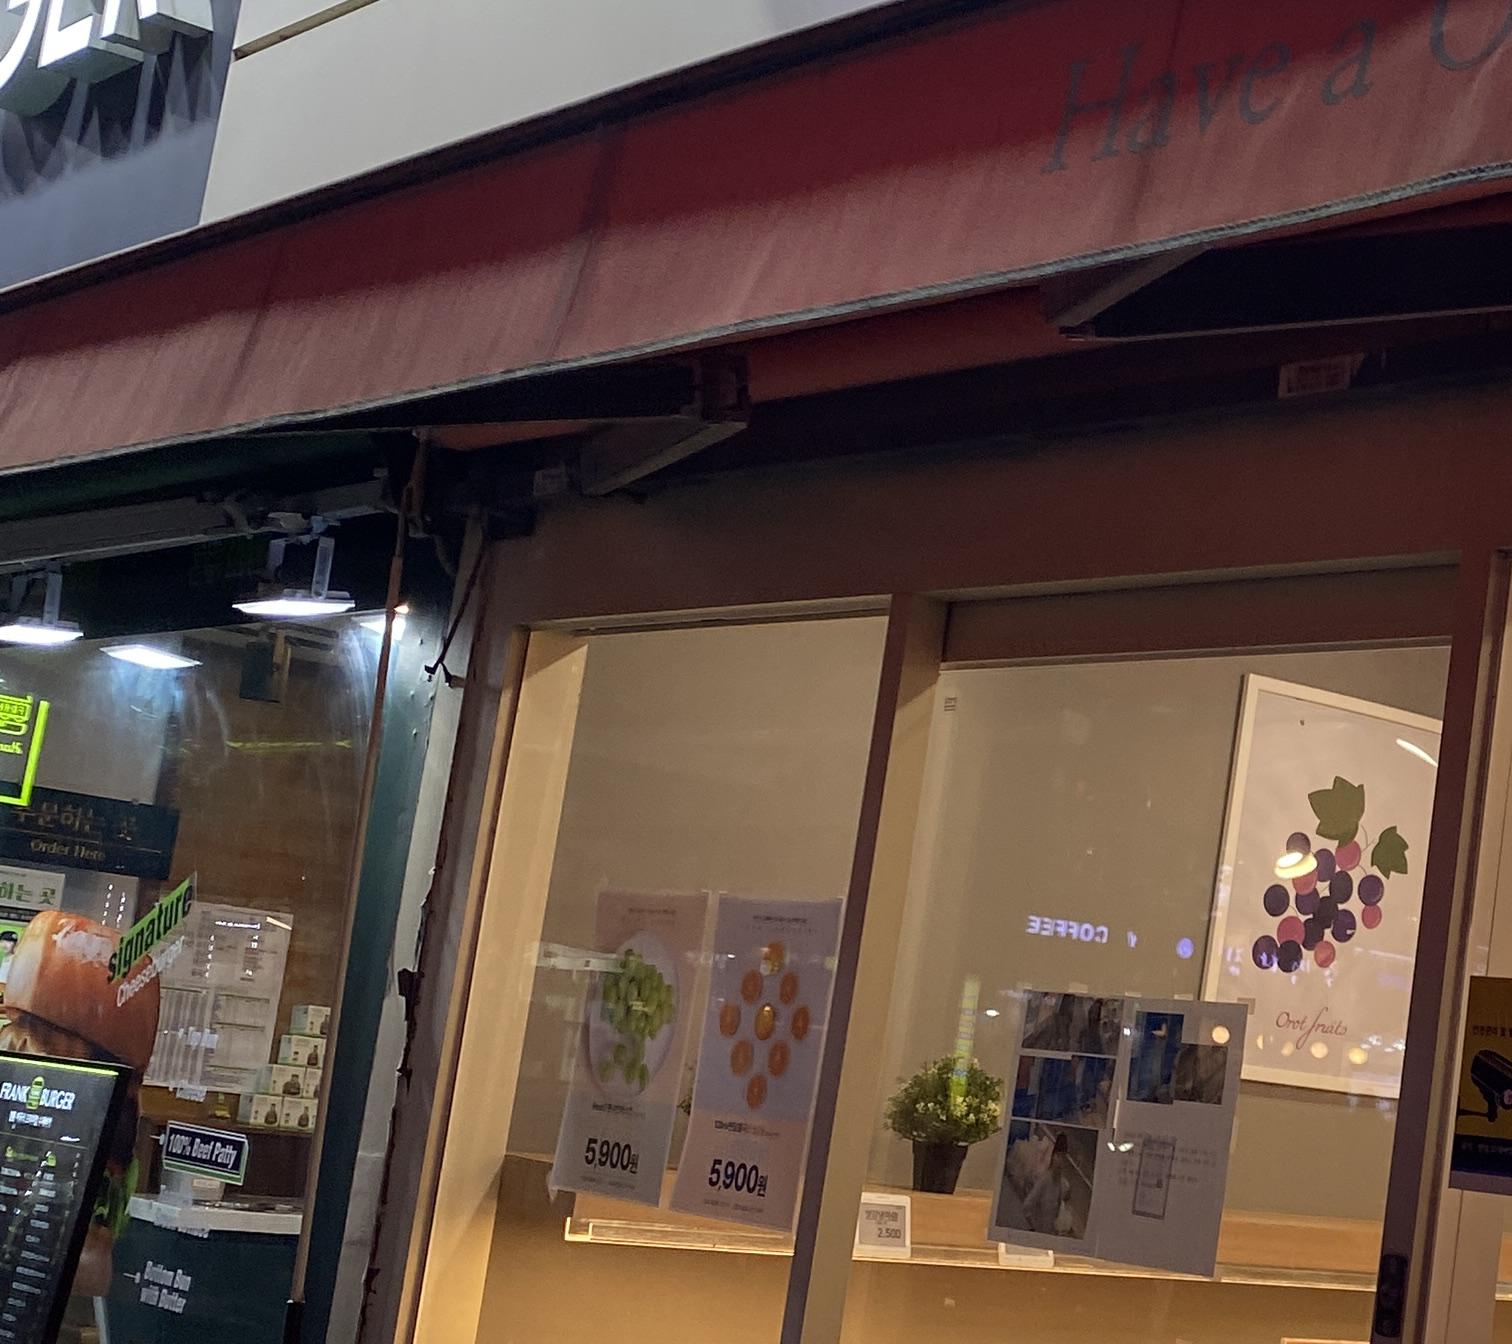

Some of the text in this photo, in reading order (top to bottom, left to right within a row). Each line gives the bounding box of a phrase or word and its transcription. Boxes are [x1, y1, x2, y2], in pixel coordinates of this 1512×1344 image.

[1041, 40, 1291, 174] Have
[1320, 17, 1379, 106] a
[30, 838, 70, 857] Order
[106, 884, 194, 985] signature
[1275, 1011, 1309, 1032] Orot
[0, 1081, 76, 1111] FRANK BURGER
[167, 1132, 238, 1169] 100% Beef Patty
[584, 1137, 640, 1174] 5,900원
[707, 1158, 769, 1198] 5,900원
